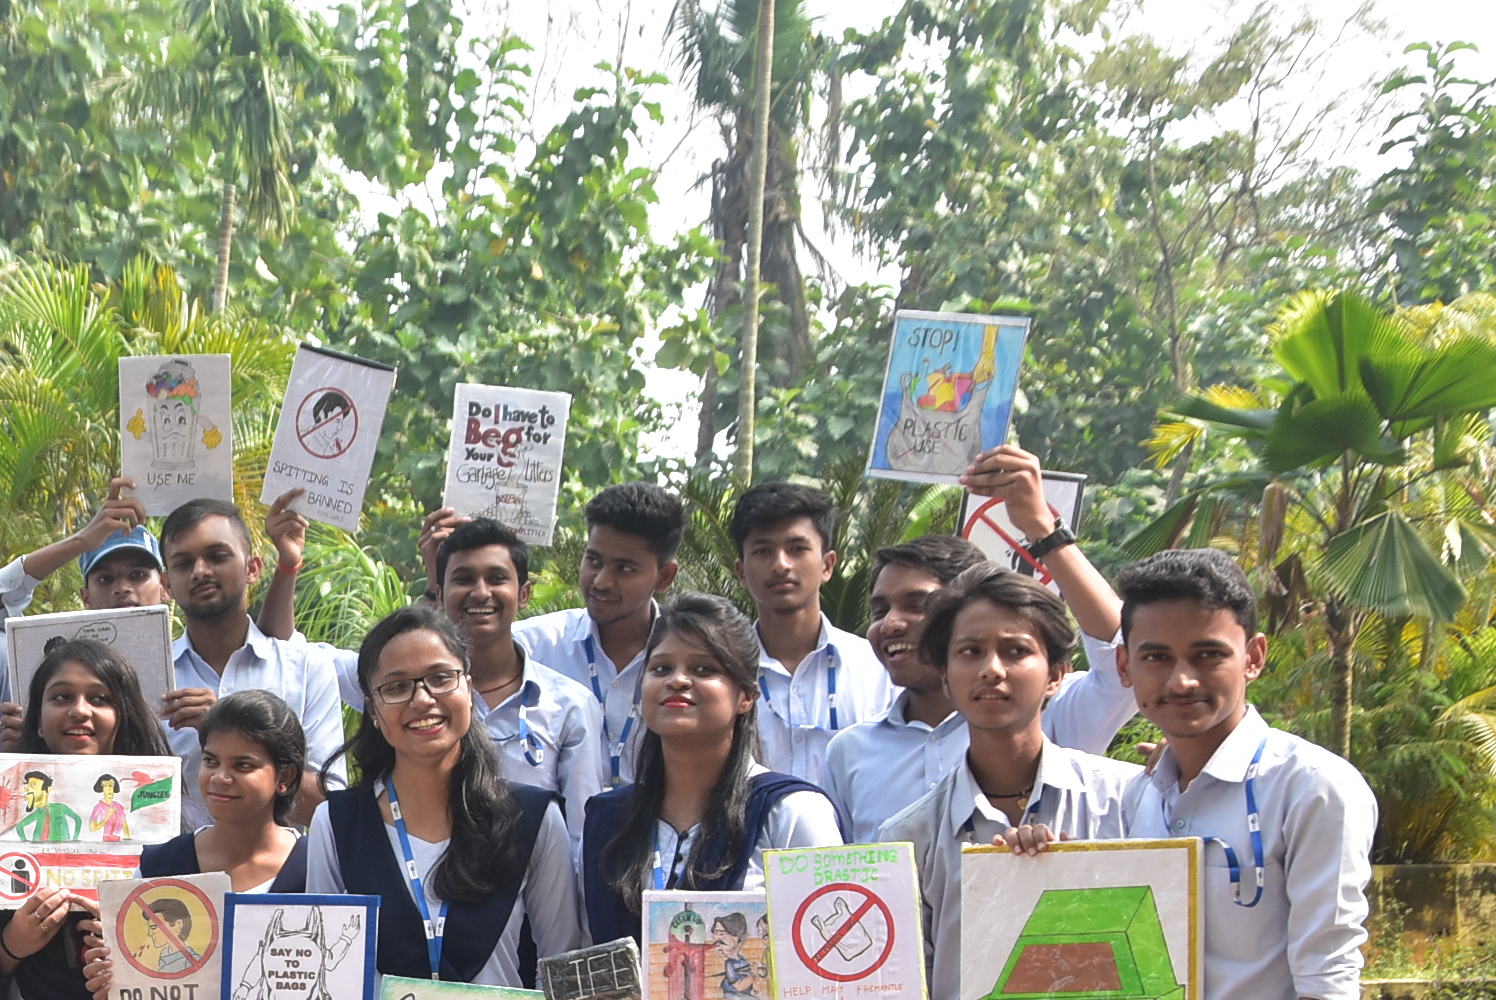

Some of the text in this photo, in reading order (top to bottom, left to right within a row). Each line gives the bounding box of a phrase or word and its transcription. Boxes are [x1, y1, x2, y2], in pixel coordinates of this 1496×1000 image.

[908, 327, 961, 354] STOP!
[468, 401, 556, 429] Do I have to
[902, 417, 968, 443] PLASTIC
[464, 417, 552, 468] Beg for
[913, 438, 941, 455] USE
[464, 447, 494, 462] Your
[147, 473, 196, 491] USE ME
[273, 460, 354, 496] SPITTING IS
[456, 458, 554, 490] Garbage Litters
[308, 491, 353, 514] BANNED
[779, 854, 809, 875] DO
[46, 868, 75, 887] NO
[814, 867, 879, 886] DRASTIC
[270, 948, 313, 957] SAY NO
[285, 959, 300, 968] TO
[268, 970, 316, 980] PLASTIC
[276, 982, 307, 991] BAGS
[783, 983, 903, 998] HELP MAKE FREMANTLE
